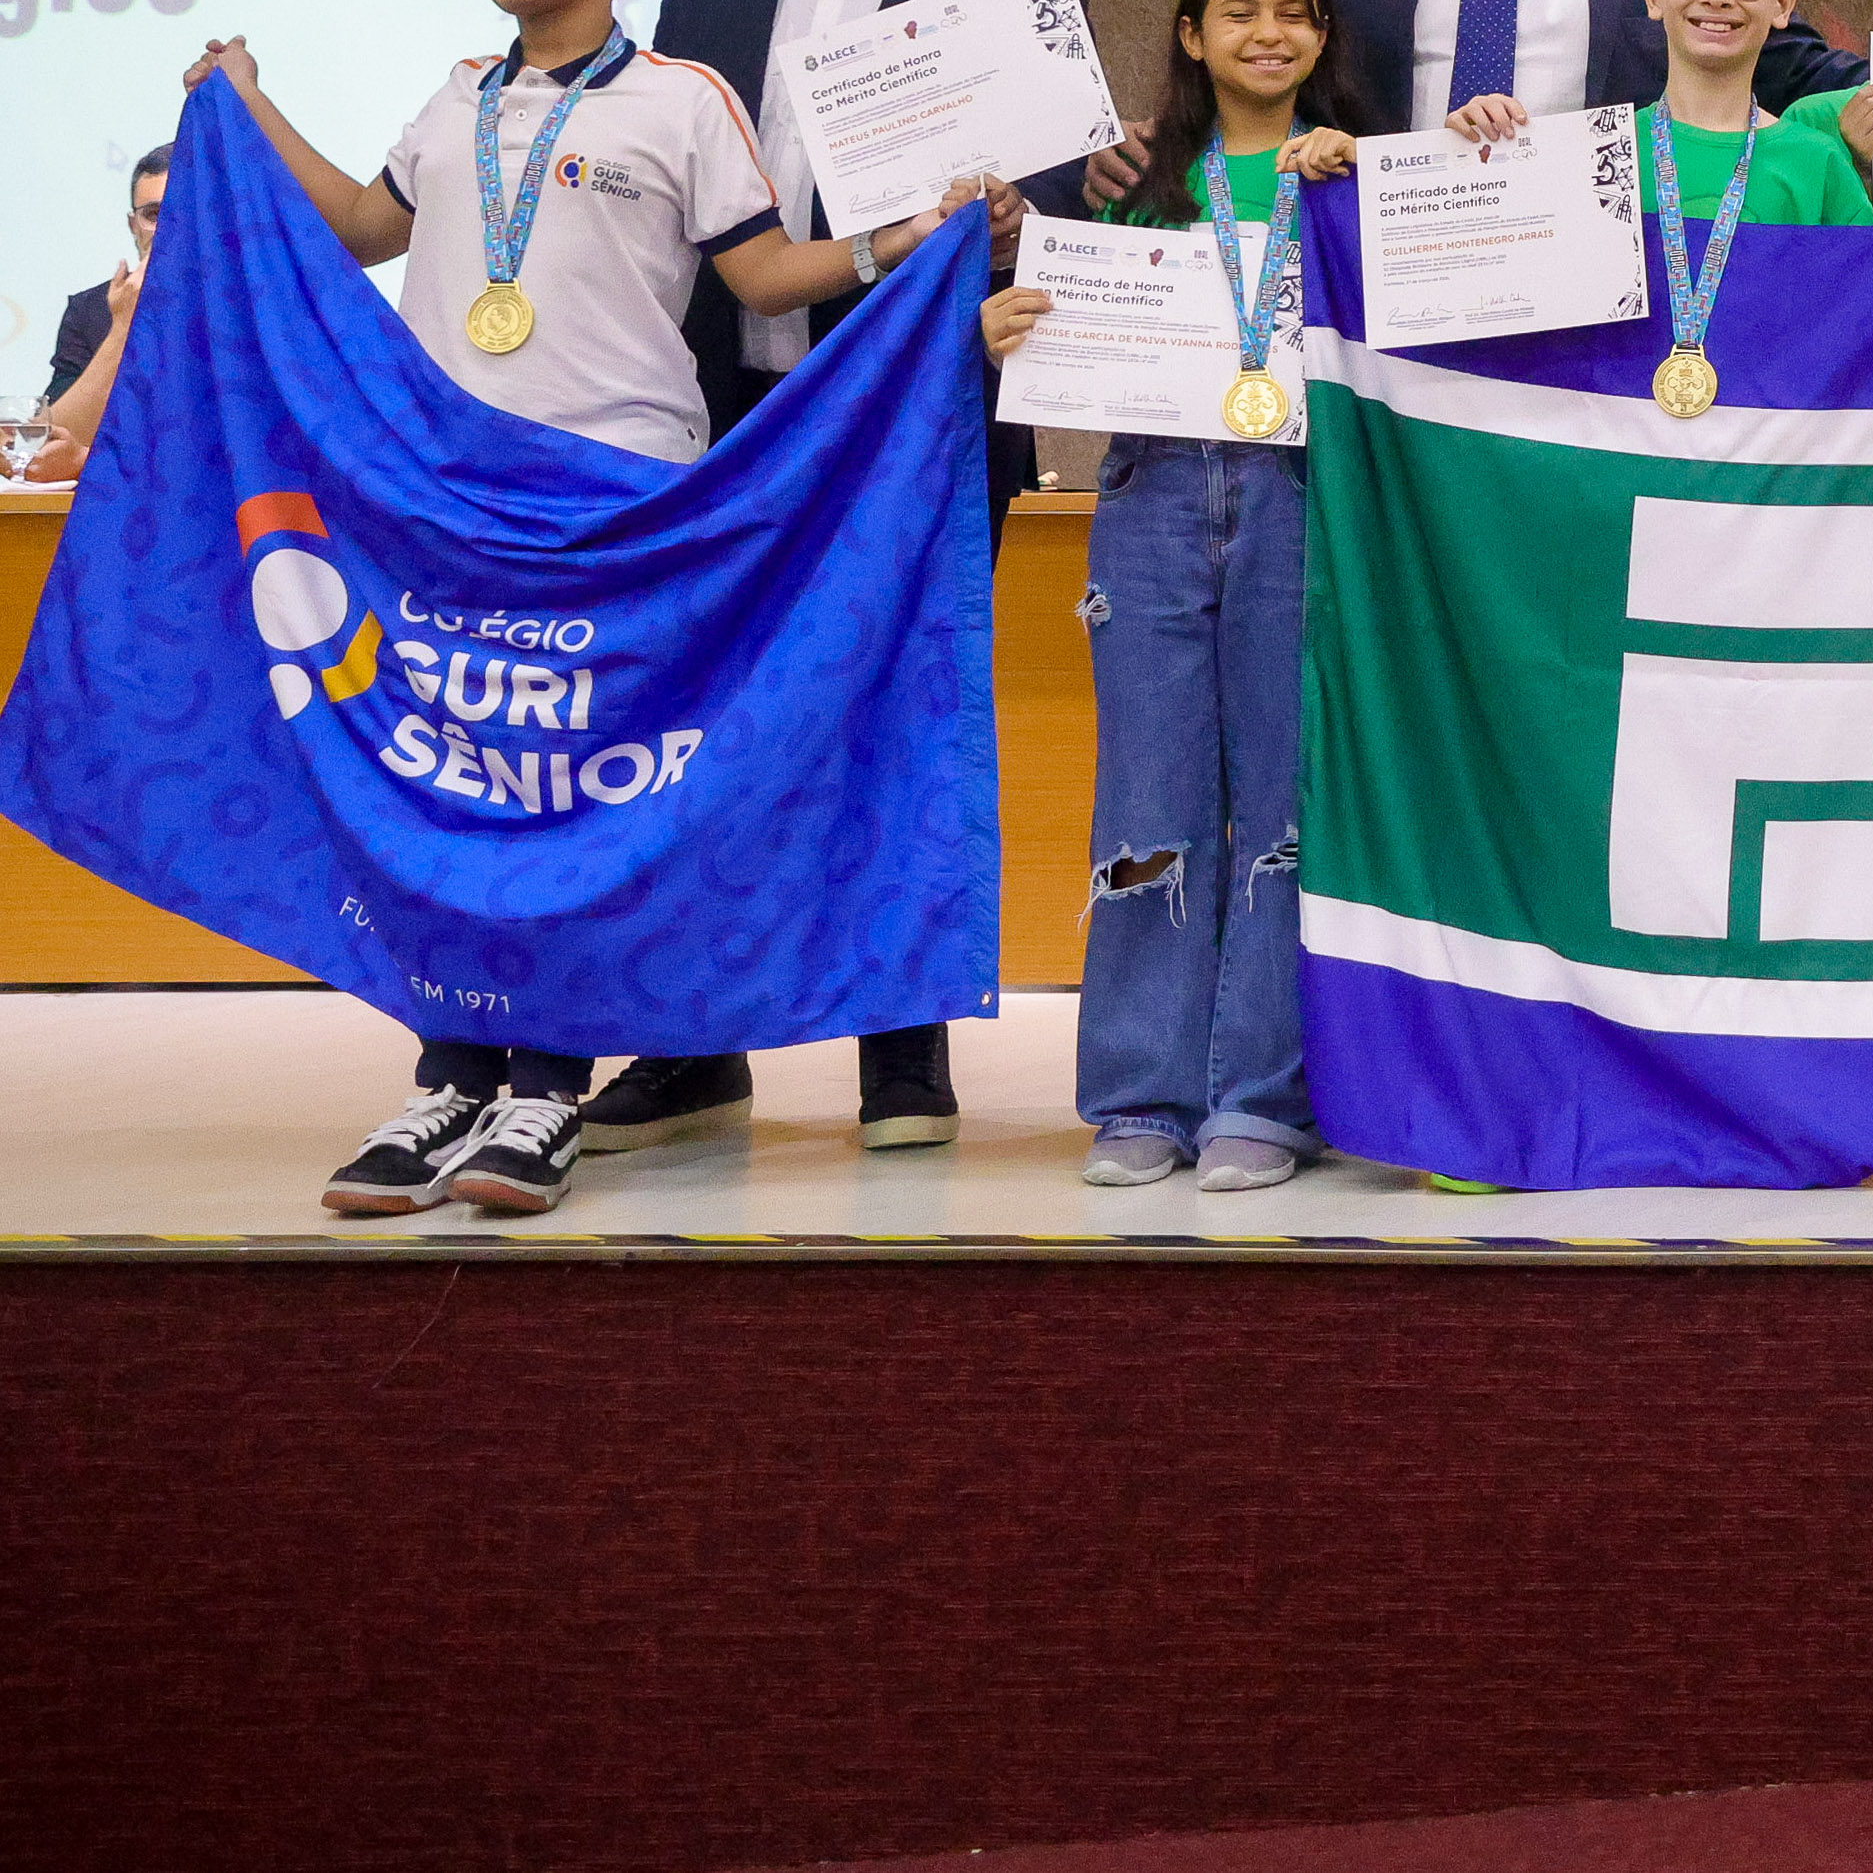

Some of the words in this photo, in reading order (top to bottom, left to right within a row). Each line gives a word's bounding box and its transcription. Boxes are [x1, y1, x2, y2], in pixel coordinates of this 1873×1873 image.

[820, 44, 857, 66] ALECE
[811, 69, 882, 101] Certificado
[884, 62, 901, 77] de
[903, 48, 942, 68] Honra
[816, 101, 833, 115] ao
[836, 84, 877, 109] Mérito
[879, 65, 938, 94] Científico
[828, 131, 870, 152] MATEUS
[872, 114, 919, 137] PAULINO
[919, 93, 974, 120] CARVALHO
[1395, 154, 1432, 169] ALECE
[593, 165, 631, 186] GURI
[590, 178, 643, 203] SÊNIOR
[1379, 186, 1449, 203] Certificado
[1451, 183, 1468, 195] de
[1470, 180, 1508, 193] Honra
[1380, 207, 1396, 218] ao
[1400, 200, 1440, 216] Mérito
[1443, 195, 1500, 211] Científico
[1059, 242, 1098, 256] ALECE
[1383, 242, 1444, 258] GUILHERME
[1446, 233, 1516, 251] MONTENEGRO
[1517, 228, 1555, 242] ARRAIS
[1036, 271, 1111, 290] Certificado
[1113, 279, 1132, 291] de
[1134, 281, 1175, 294] Honra
[1056, 287, 1099, 304] Mérito
[1101, 293, 1164, 308] Científico
[1073, 330, 1116, 342] GARCIA
[1117, 333, 1133, 344] DE
[1135, 334, 1168, 346] PAIVA
[1169, 336, 1213, 350] VIANNA
[393, 640, 594, 730] GURI
[378, 713, 704, 815] SÊNIOR
[455, 988, 511, 1014] 1971
